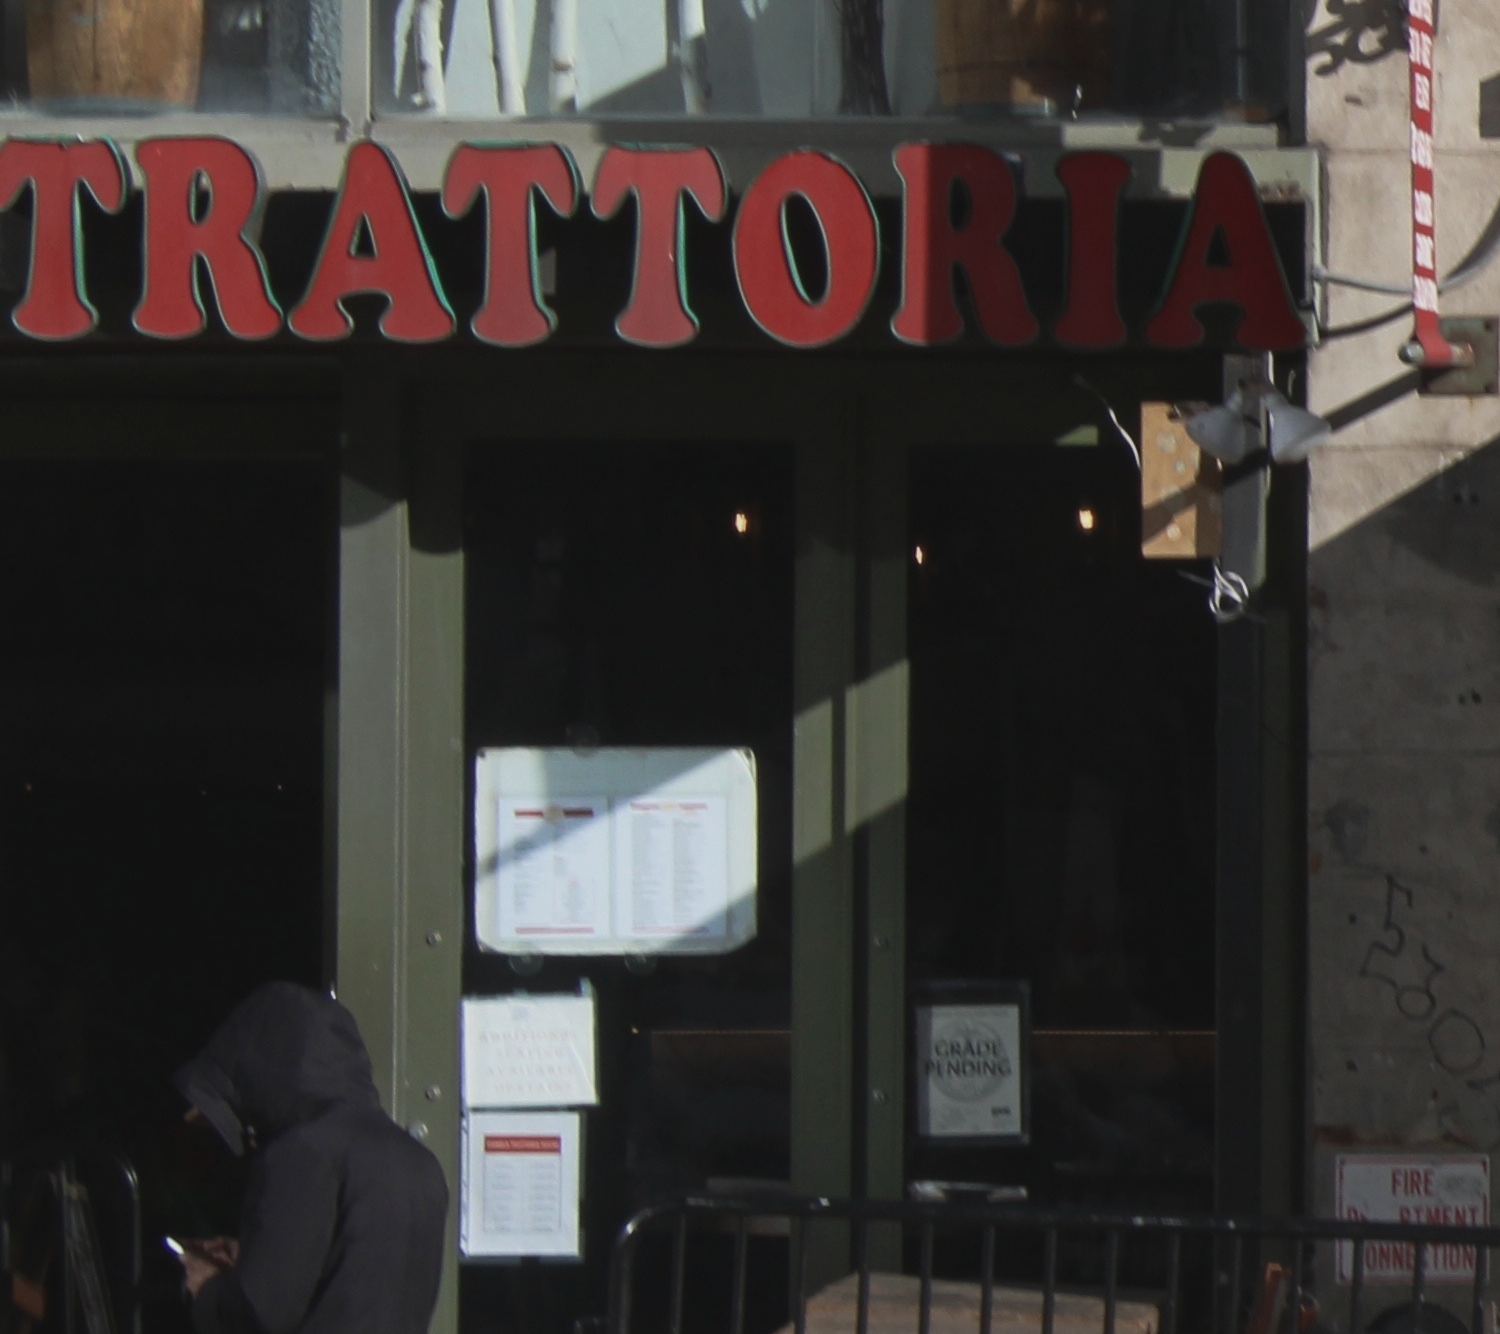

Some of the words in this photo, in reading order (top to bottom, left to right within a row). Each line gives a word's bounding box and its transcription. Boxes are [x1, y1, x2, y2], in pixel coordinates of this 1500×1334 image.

[0, 134, 1308, 349] TRATTORIA
[1391, 1168, 1434, 1197] FIRE
[1346, 1205, 1477, 1226] DRTMENT
[1364, 1241, 1476, 1271] ONNETION
